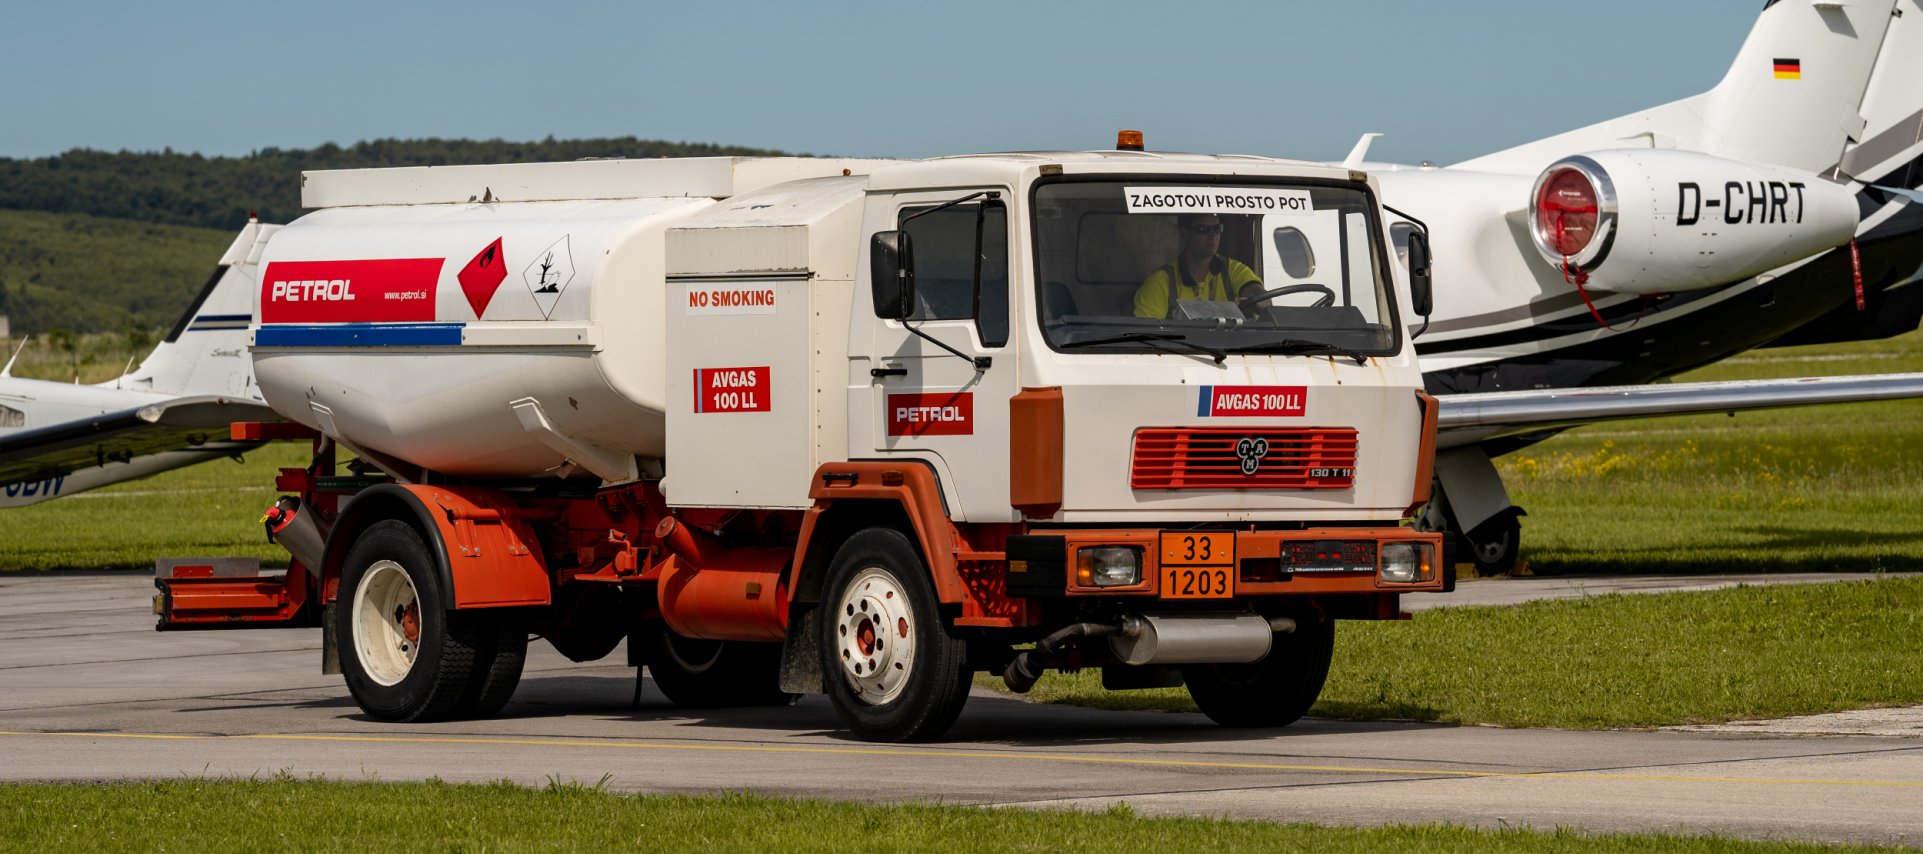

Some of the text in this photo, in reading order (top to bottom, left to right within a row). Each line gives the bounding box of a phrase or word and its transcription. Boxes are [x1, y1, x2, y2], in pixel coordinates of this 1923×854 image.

[1130, 194, 1307, 211] ZAGOTOVI PROSTO POT
[1676, 181, 1806, 226] D-CHRT
[271, 279, 356, 302] PETROL
[384, 289, 427, 301] www.petrol.si
[689, 289, 775, 307] NO SMOKING
[712, 370, 757, 388] AVGAS
[713, 391, 758, 409] 100 LL
[1216, 393, 1301, 410] AVGAS 100 LL
[896, 406, 965, 422] PETROL
[1311, 468, 1329, 477] 130
[1332, 468, 1339, 477] T
[1183, 536, 1211, 561] 33
[1169, 570, 1226, 595] 1203
